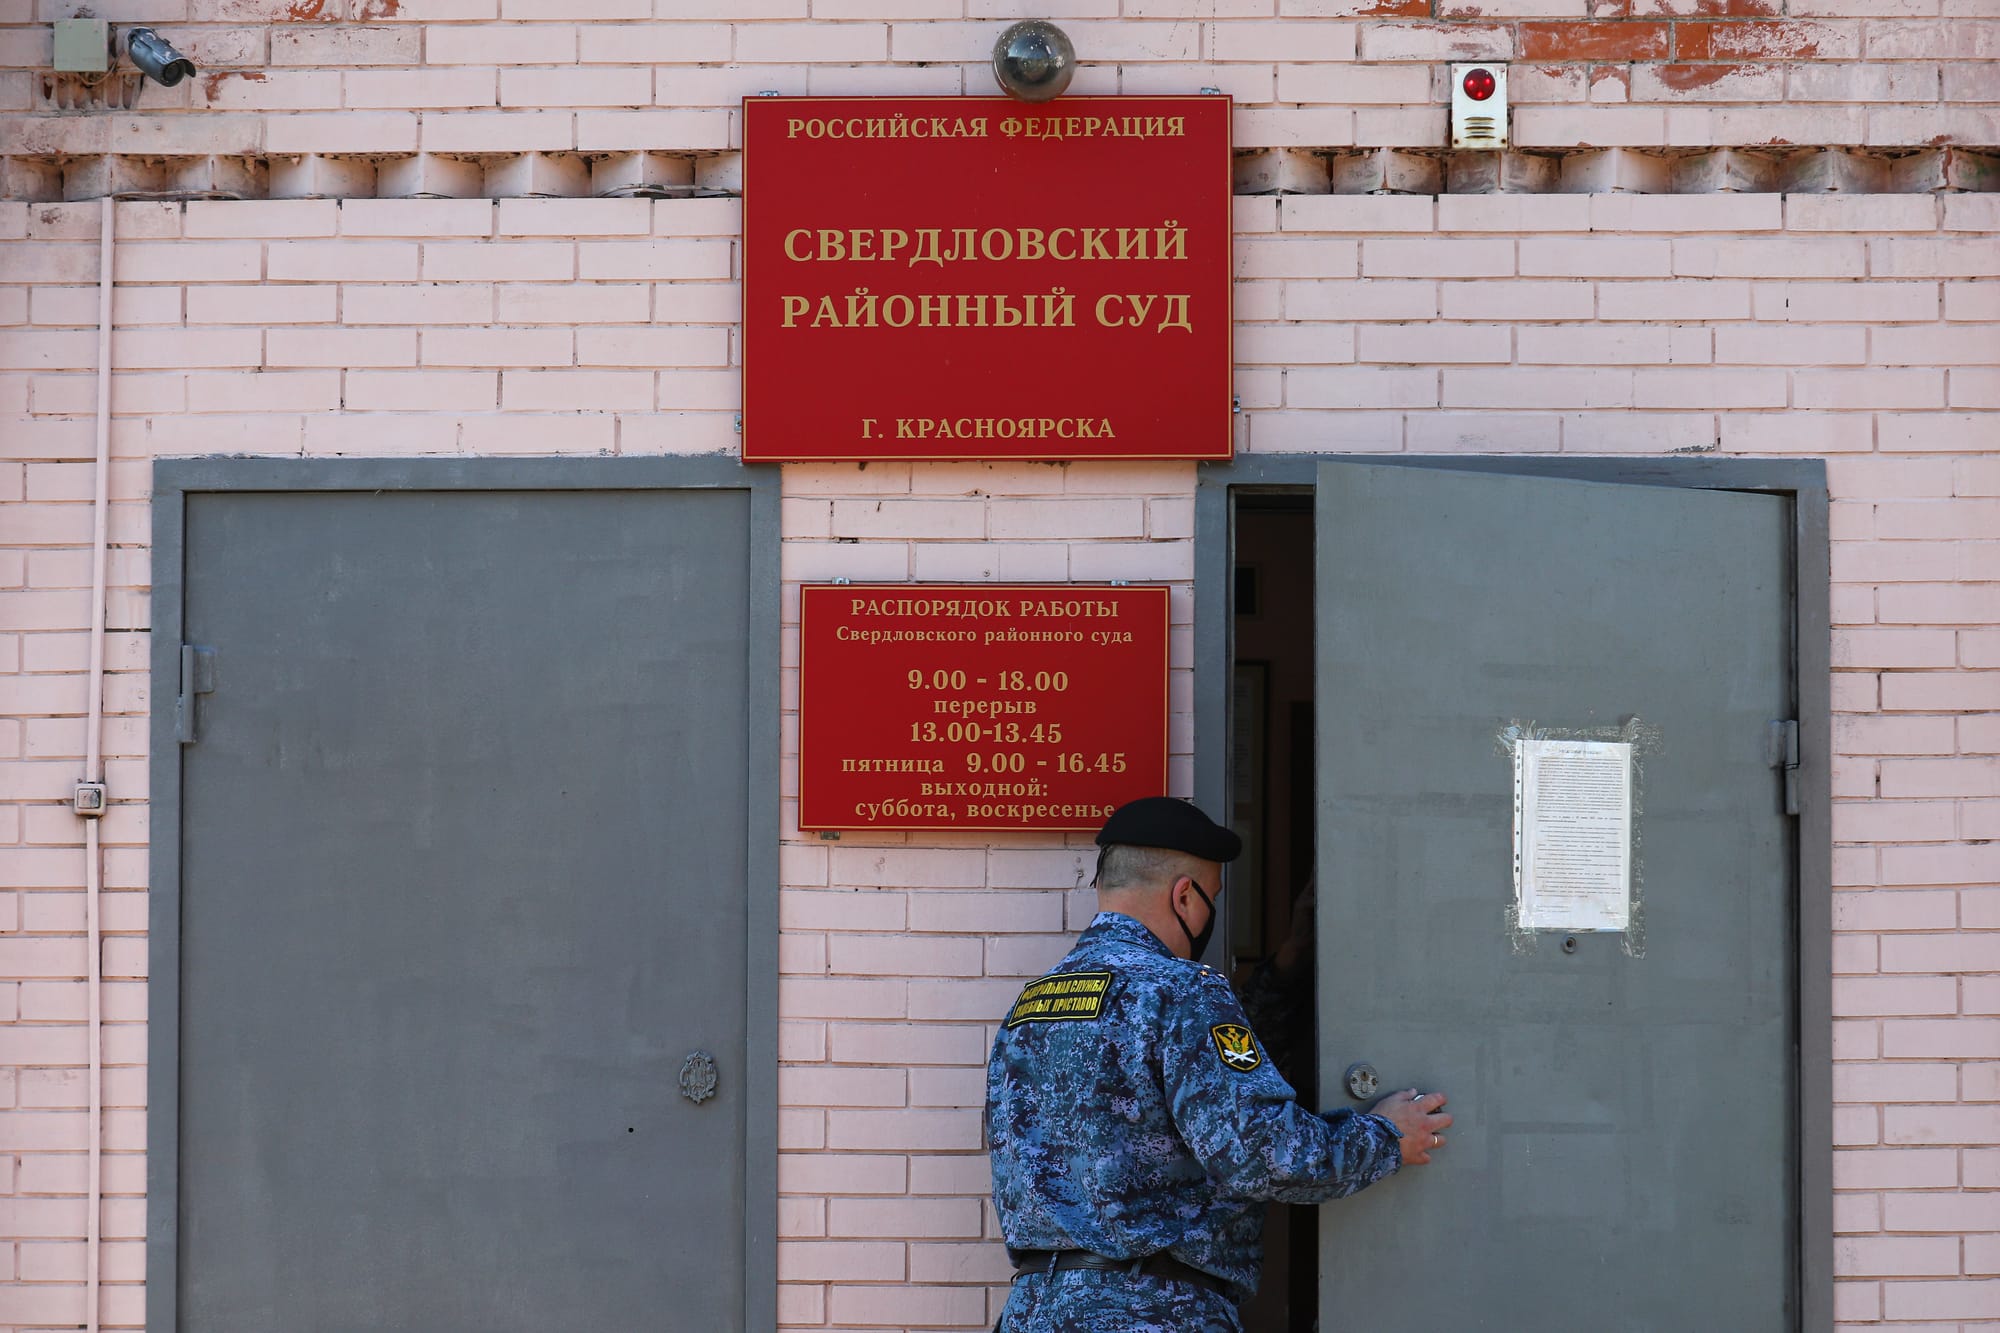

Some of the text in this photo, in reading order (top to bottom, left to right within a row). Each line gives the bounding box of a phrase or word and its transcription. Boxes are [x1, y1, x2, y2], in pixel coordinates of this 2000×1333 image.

[787, 113, 1185, 141] РОССИЙСКАЯ ФЕДЕРАЦИЯ
[784, 219, 1188, 268] СВЕРДЛОВСКИЙ
[781, 287, 1192, 333] РАЙОННЫЙ СУД
[862, 418, 1116, 439] Г. КРАСНОЯРСКА
[850, 599, 1119, 619] РАСПОРЯДОК РАБОТЫ
[836, 626, 1133, 645] Свердловского районного суда
[908, 669, 967, 690] 9.00
[998, 671, 1069, 692] 18.00
[934, 700, 1037, 719] перерыв
[911, 722, 1062, 743] 13.00-13.45
[842, 759, 945, 774] пятница
[966, 753, 1025, 773] 9.00
[1057, 753, 1127, 773] 16.45
[921, 778, 1048, 798] выходной:
[855, 799, 1115, 822] суббота, воскресенье
[1070, 979, 1105, 992] СЛУЖБА
[1052, 997, 1098, 1011] ПРИСТАВОВ
